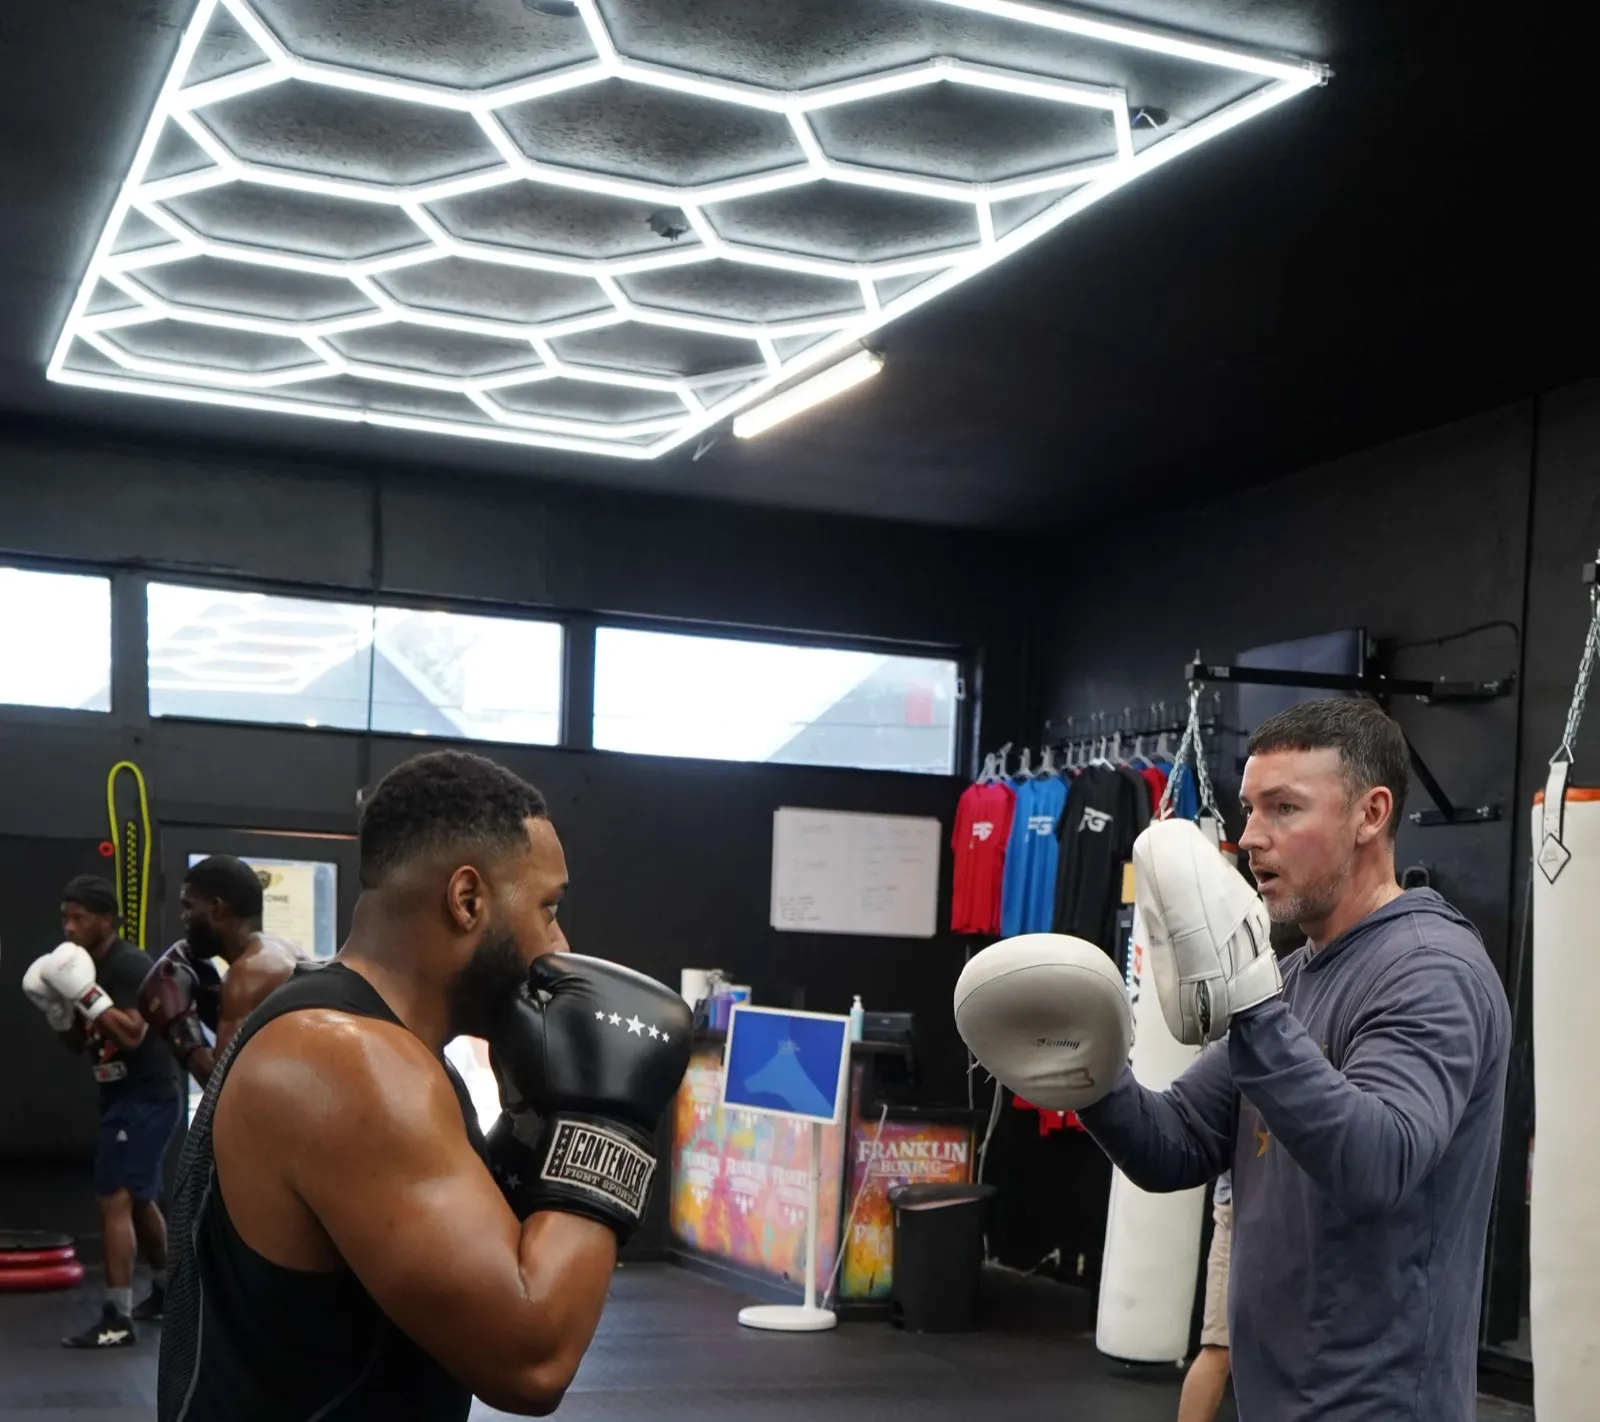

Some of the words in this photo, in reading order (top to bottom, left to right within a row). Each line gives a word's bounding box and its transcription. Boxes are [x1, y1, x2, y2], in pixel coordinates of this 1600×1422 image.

[570, 1130, 649, 1196] CONTENDER
[857, 1140, 968, 1163] FRANKLIN
[880, 1160, 941, 1174] BOXING
[564, 1167, 601, 1185] FIGHT
[602, 1179, 638, 1208] SPORTS
